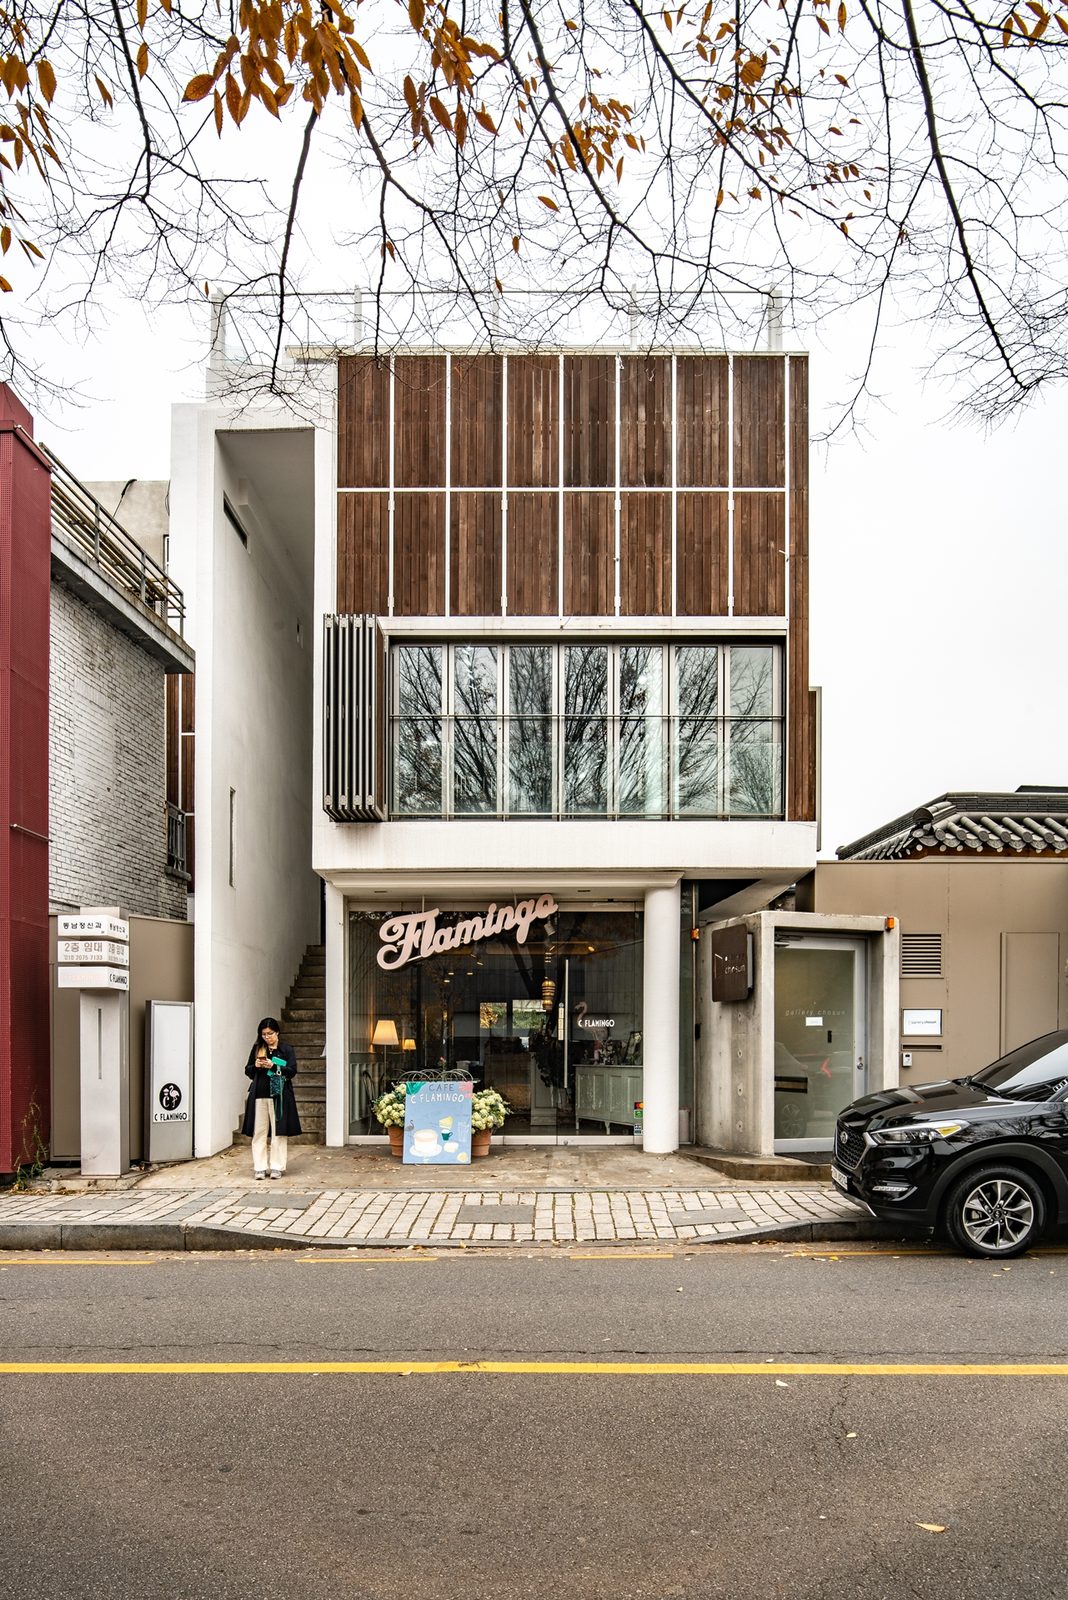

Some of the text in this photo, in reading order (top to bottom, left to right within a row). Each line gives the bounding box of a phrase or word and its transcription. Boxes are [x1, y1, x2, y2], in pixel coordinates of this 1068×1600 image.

[376, 893, 559, 970] Flamingo
[84, 942, 102, 952] 임대
[578, 1020, 615, 1028] C FLAMINGO
[429, 1084, 454, 1092] CAFE
[411, 1093, 464, 1104] C FLAMINGO
[160, 1112, 187, 1120] FLAMINGO
